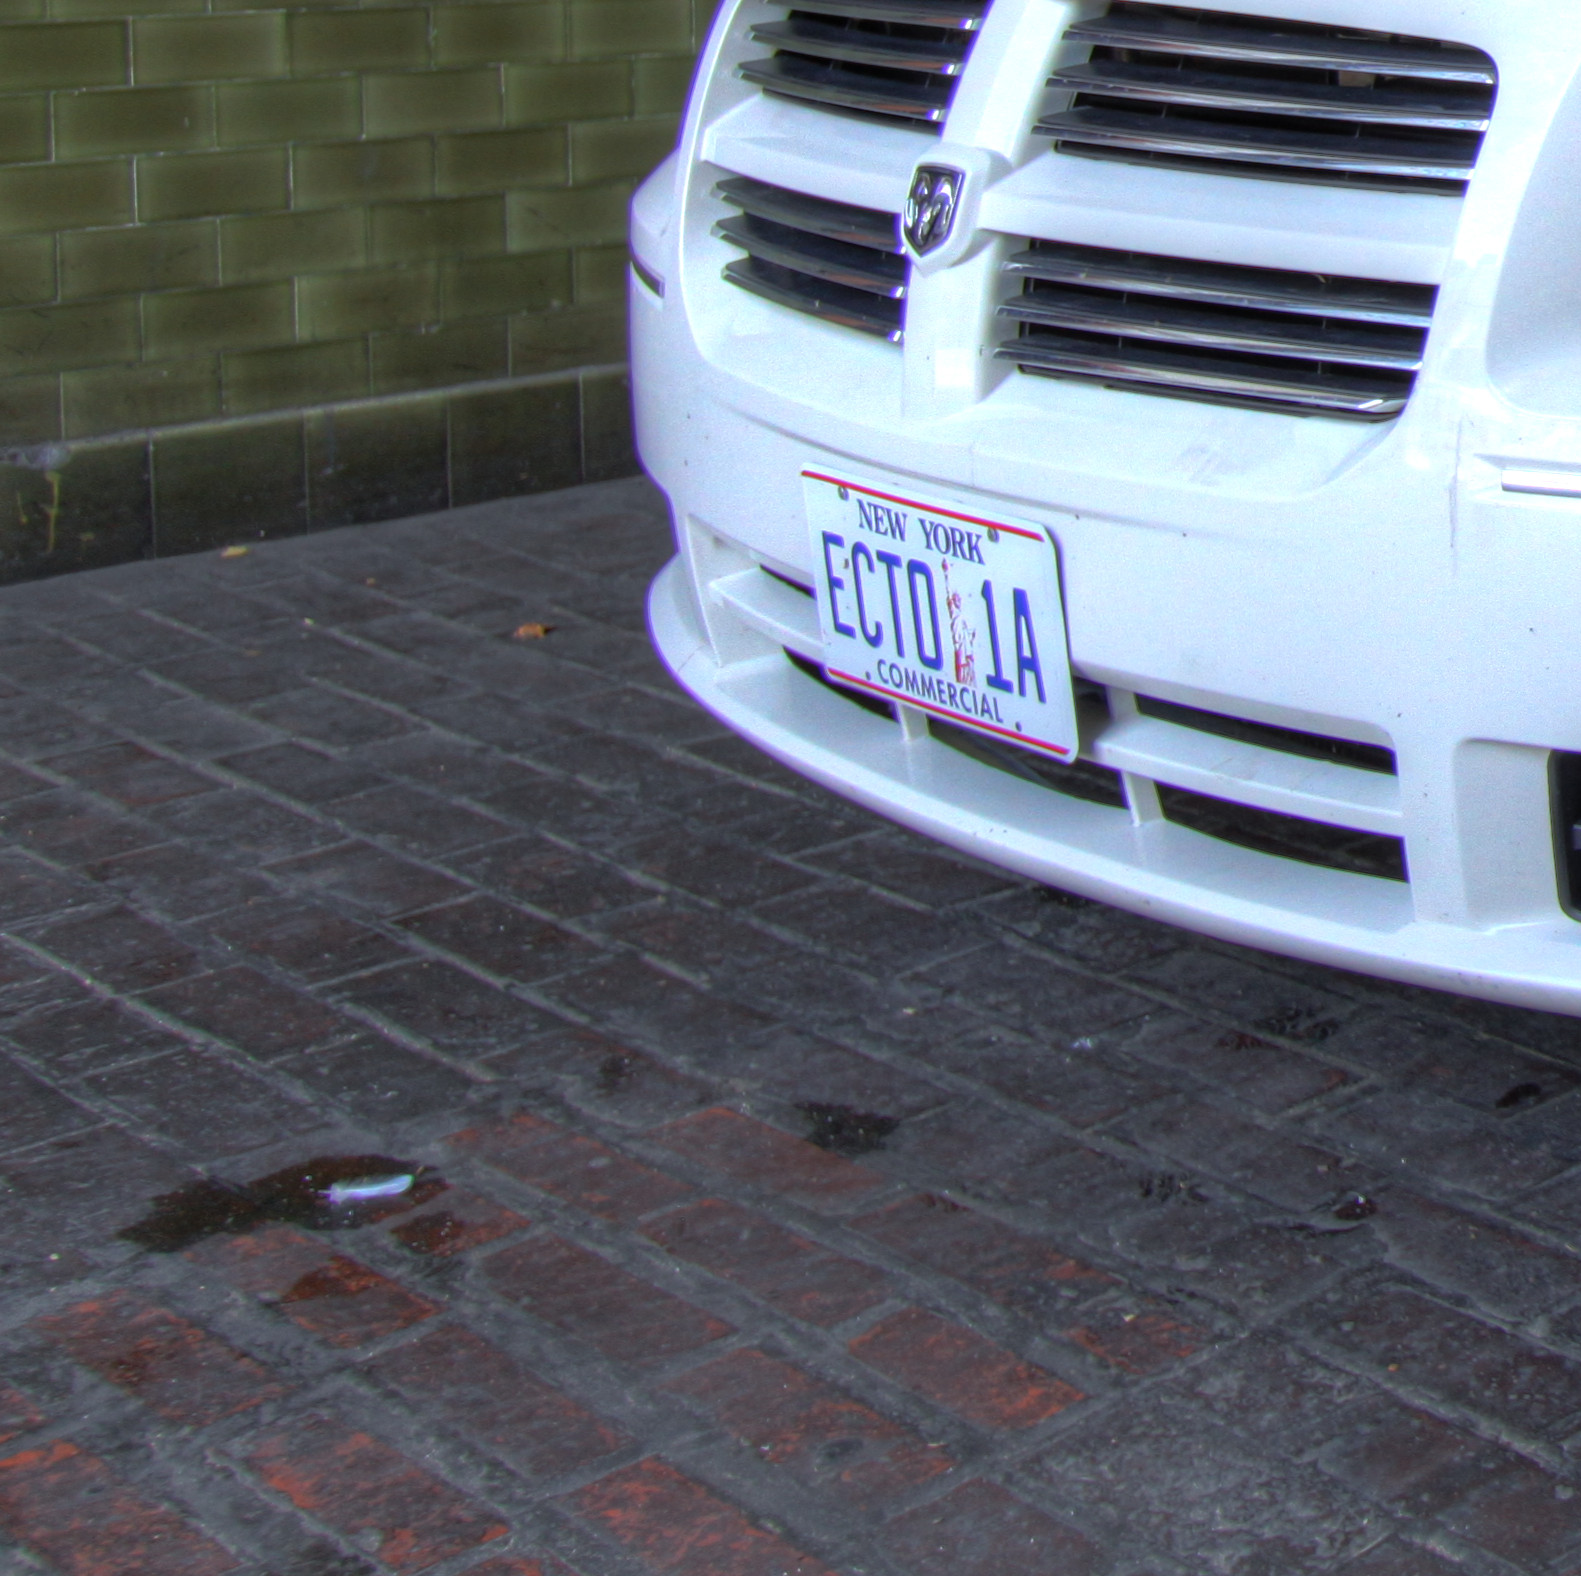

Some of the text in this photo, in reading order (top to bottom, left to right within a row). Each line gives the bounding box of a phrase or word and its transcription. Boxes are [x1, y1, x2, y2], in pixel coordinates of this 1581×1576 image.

[857, 499, 986, 565] NEW YORK
[821, 530, 1047, 704] ECTO 1A
[877, 659, 1004, 723] COMMERCIAL
